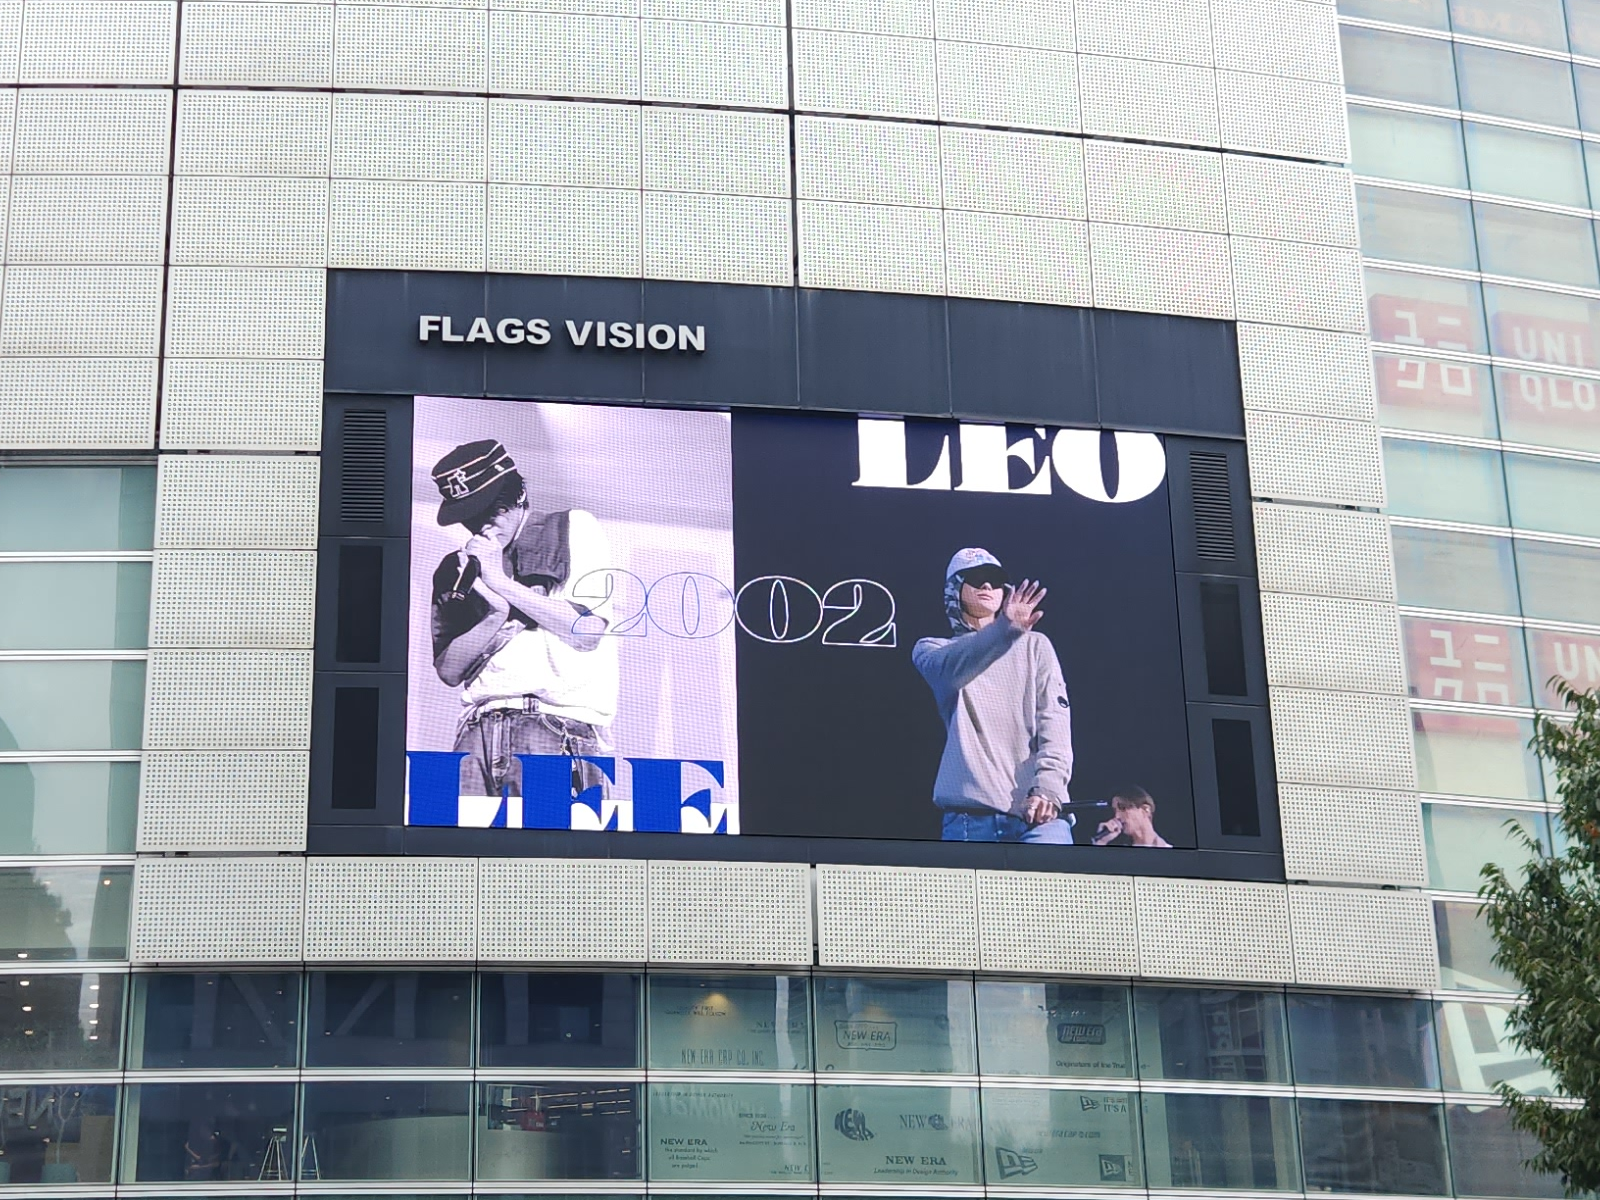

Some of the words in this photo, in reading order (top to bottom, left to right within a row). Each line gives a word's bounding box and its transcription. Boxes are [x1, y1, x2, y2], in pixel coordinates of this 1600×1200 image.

[418, 314, 552, 346] FLAGS
[564, 319, 707, 352] VISION
[1512, 326, 1584, 367] UNI
[1519, 374, 1596, 413] QLO
[851, 417, 1167, 504] LEO
[571, 567, 897, 648] 2002
[404, 749, 729, 835] LEE
[842, 1030, 867, 1041] NEW
[870, 1031, 891, 1042] ERA
[681, 1048, 696, 1065] NEW
[899, 1114, 927, 1130] NEW
[660, 1138, 685, 1146] NEW
[687, 1138, 708, 1146] ERA
[885, 1155, 915, 1166] NEW
[920, 1156, 947, 1167] ERA
